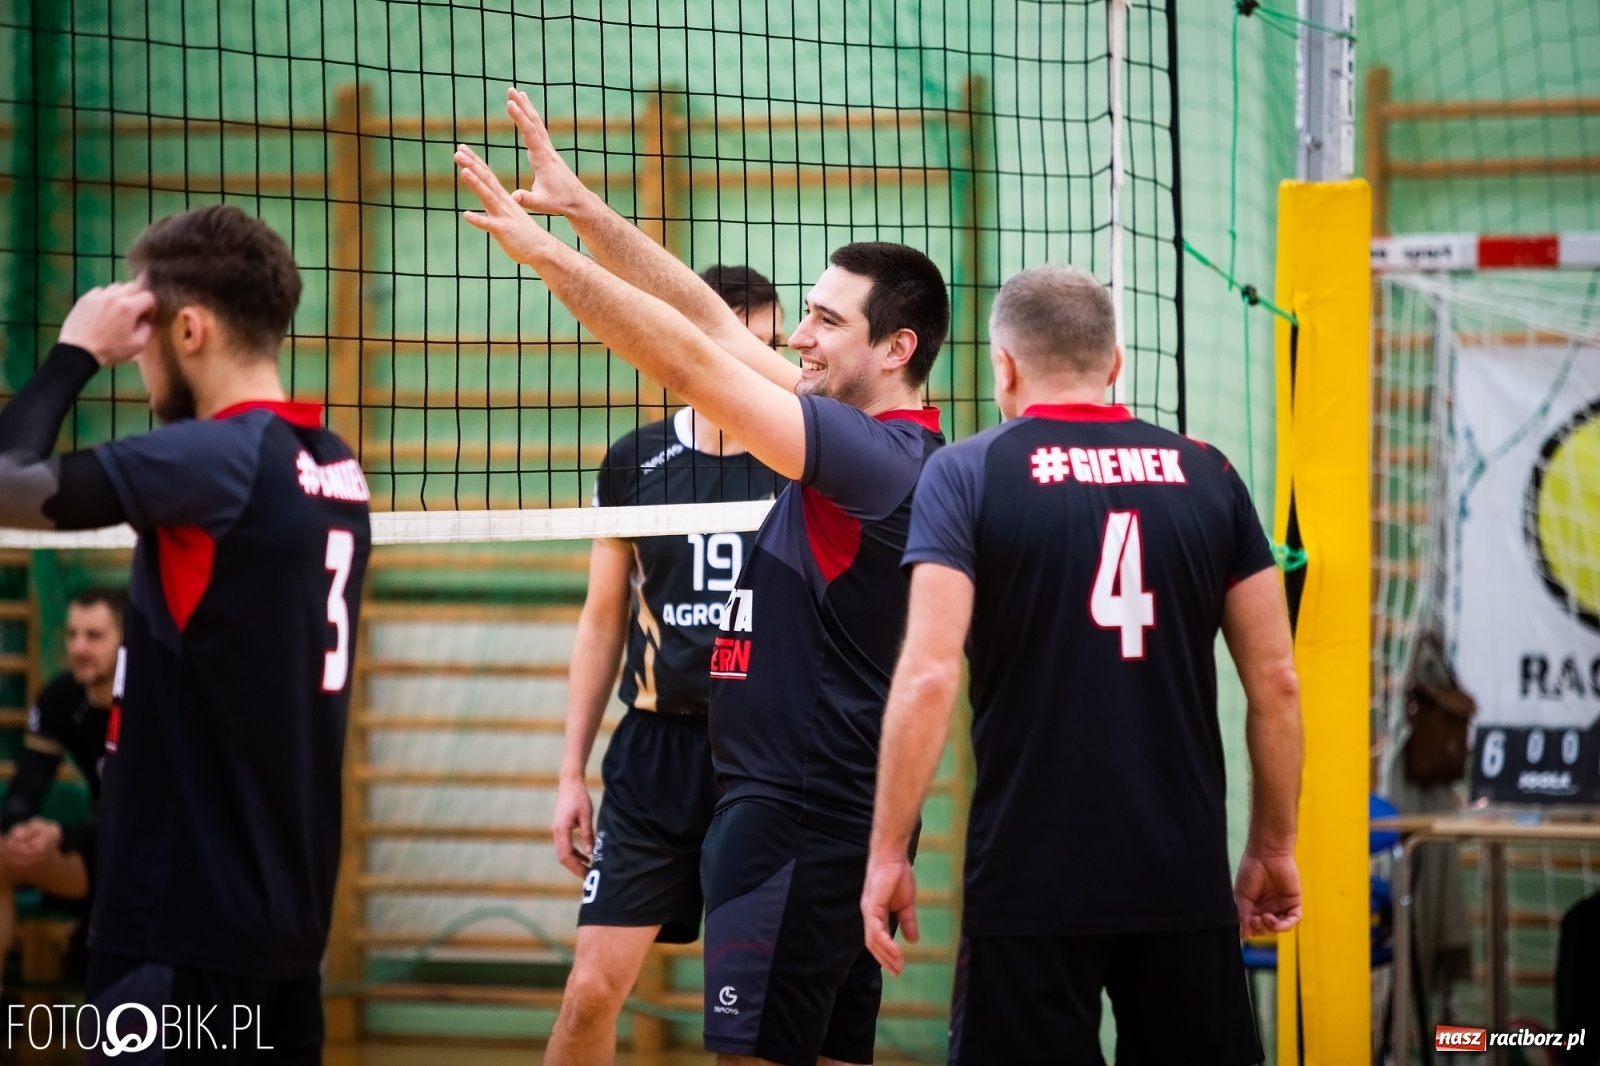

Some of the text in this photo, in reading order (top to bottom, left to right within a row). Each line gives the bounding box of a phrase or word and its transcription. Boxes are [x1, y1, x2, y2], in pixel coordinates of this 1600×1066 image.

[321, 528, 355, 692] 3
[687, 533, 743, 591] 19
[1089, 509, 1156, 660] 4
[1481, 729, 1506, 779] 6
